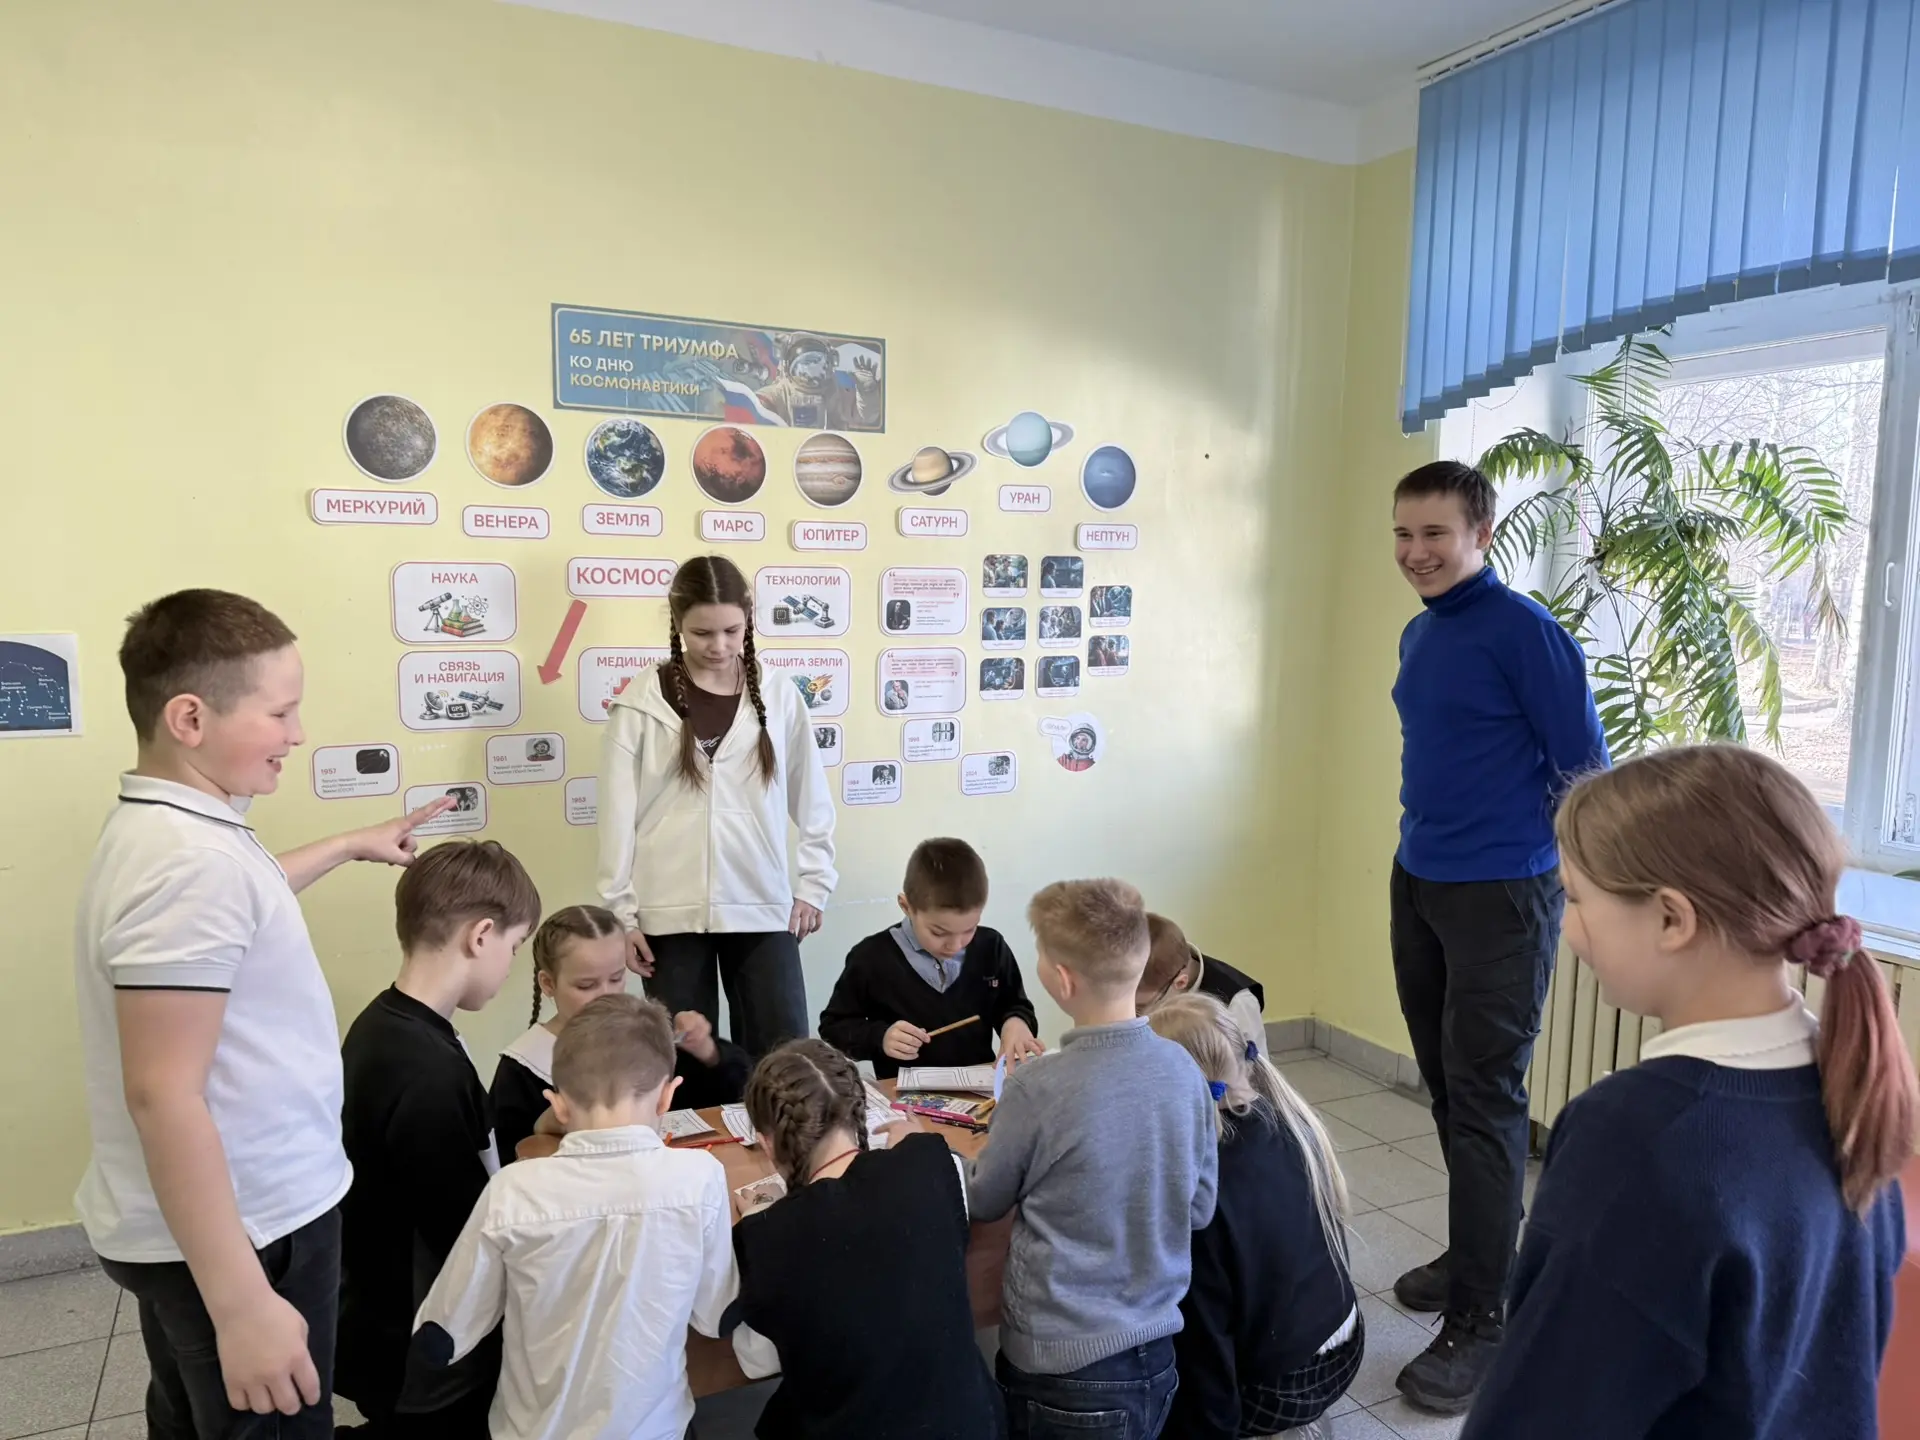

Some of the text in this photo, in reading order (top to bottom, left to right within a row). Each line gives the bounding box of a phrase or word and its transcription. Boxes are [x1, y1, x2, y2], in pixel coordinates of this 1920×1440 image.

[569, 328, 739, 360] 65 ЛЕТ ТРИУМФА
[569, 355, 633, 373] КО ДНЮ
[570, 373, 700, 396] КОСМОНАВТИКИ
[1009, 492, 1041, 505] УРАН
[326, 498, 425, 516] МЕРКУРИЙ
[473, 514, 539, 530] ВЕНЕРА
[595, 511, 650, 527] ЗЕМЛЯ
[712, 519, 754, 533] МАРС
[910, 514, 958, 529] САТУРН
[803, 528, 860, 542] ЮПИТЕР
[1086, 530, 1130, 543] НЕПТУН
[431, 572, 479, 585] НАУКА
[576, 566, 672, 586] КОСМОС
[765, 574, 841, 586] ТЕХНОЛОГИИ
[438, 661, 481, 672] СВЯЗЬ
[763, 657, 843, 668] ЗАЩИТА ЗЕМЛИ
[414, 671, 505, 685] И НАВИГАЦИЯ
